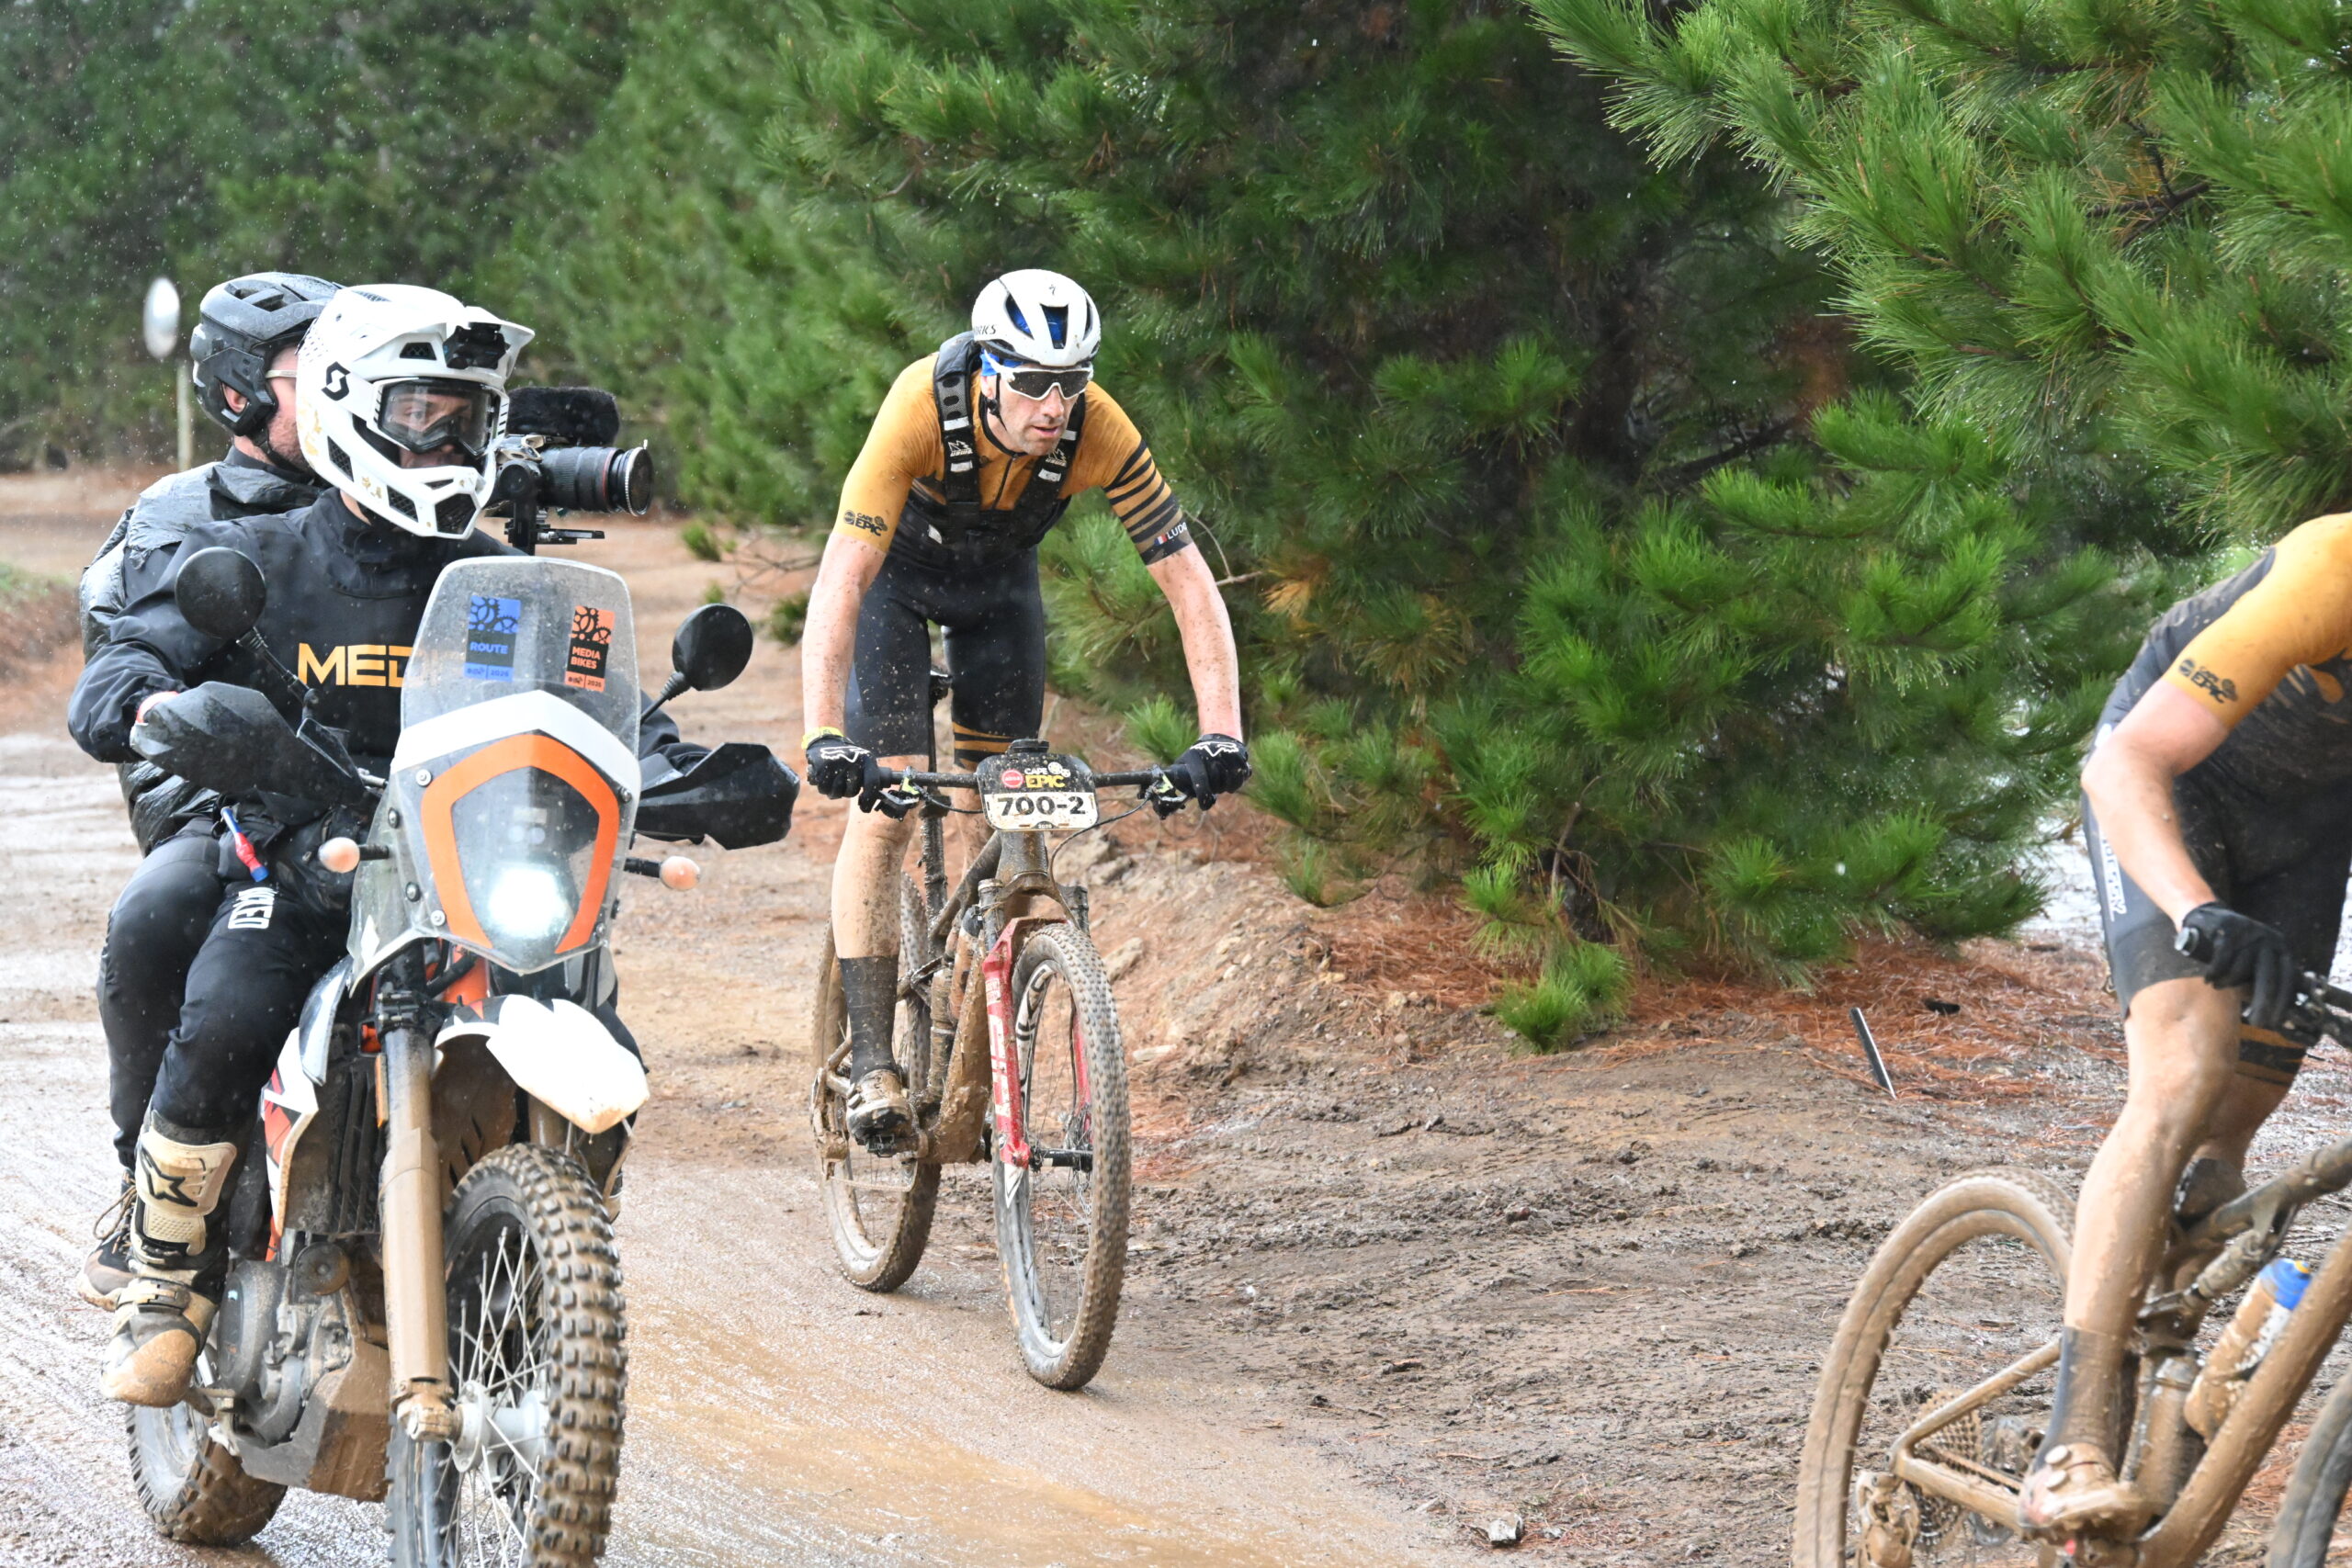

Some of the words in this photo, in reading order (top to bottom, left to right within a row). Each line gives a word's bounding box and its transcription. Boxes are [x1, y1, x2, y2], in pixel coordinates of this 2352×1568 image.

[854, 518, 882, 536] EPIC
[469, 641, 508, 654] ROUTE
[571, 647, 601, 660] MEDIA
[571, 656, 597, 670] BIKES
[2190, 671, 2225, 704] EPIC
[1024, 767, 1047, 775] CAPE
[1024, 774, 1066, 788] EPIC
[997, 795, 1086, 817] 700-2
